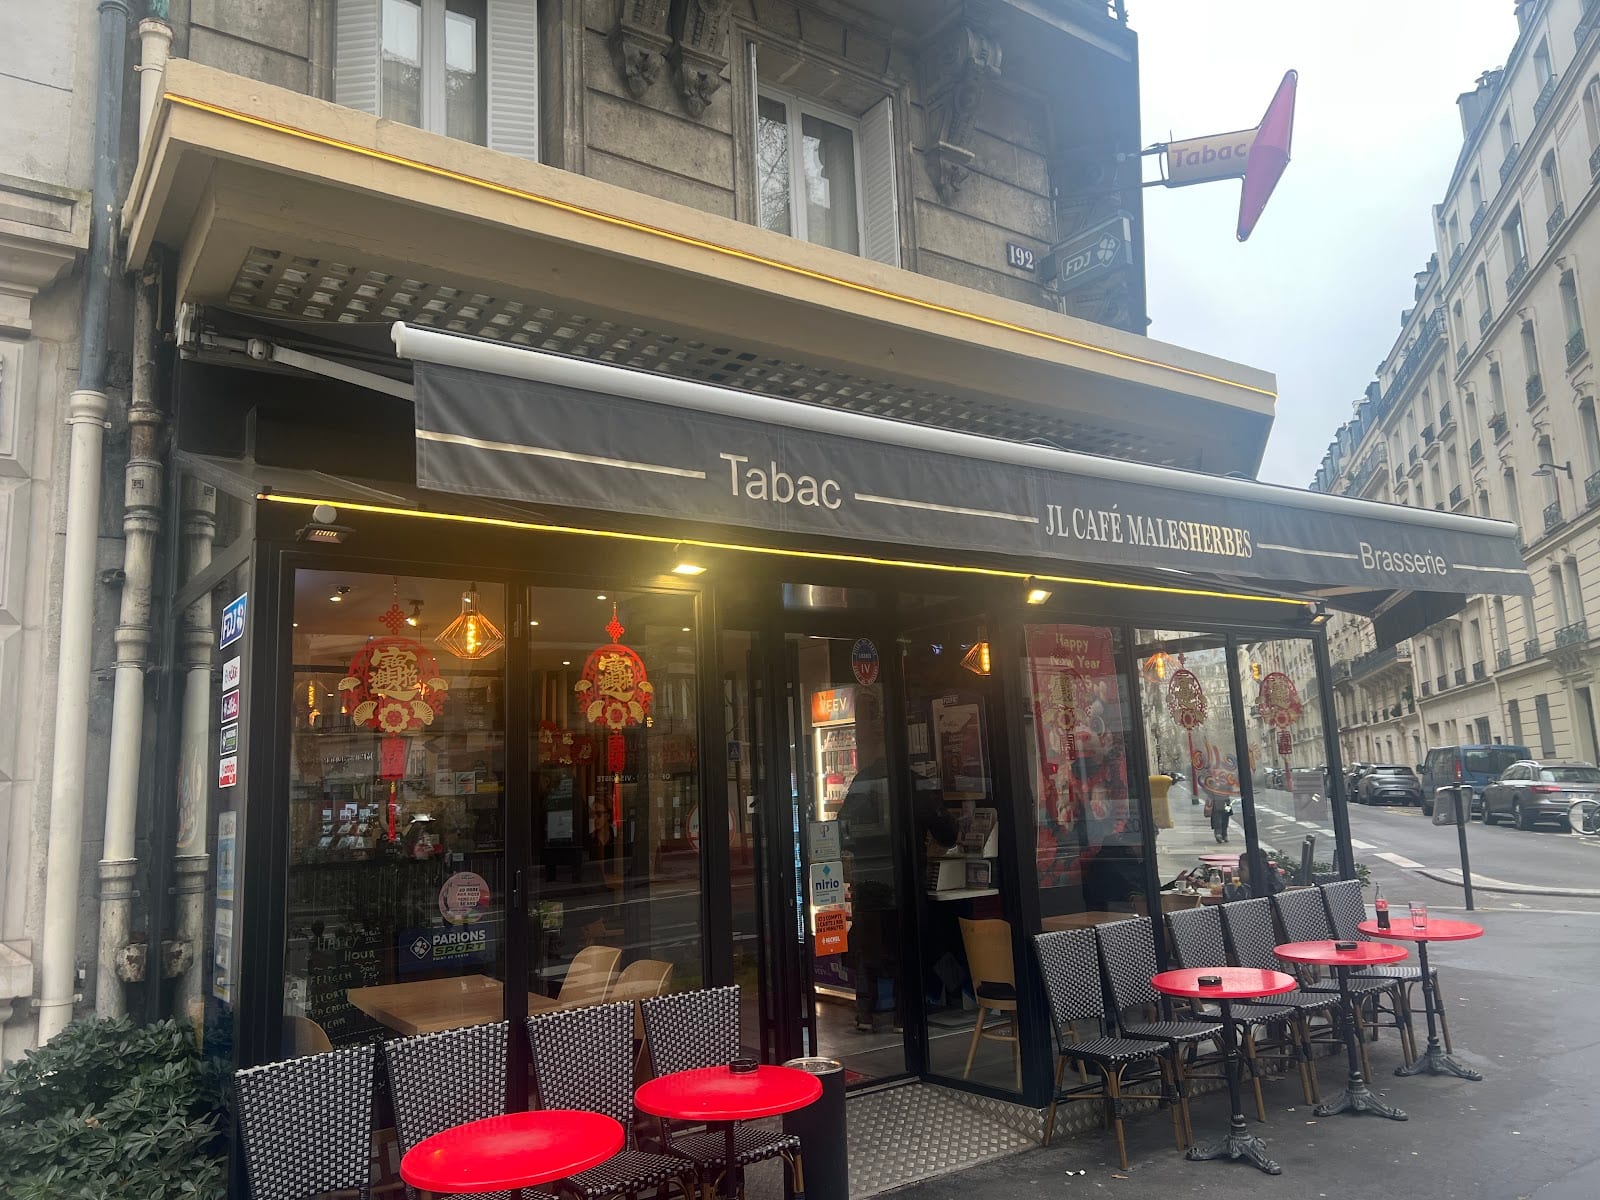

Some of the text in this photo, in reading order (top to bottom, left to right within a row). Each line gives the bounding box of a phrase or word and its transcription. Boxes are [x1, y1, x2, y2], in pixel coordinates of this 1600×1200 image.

[1173, 143, 1247, 167] Tabac
[1009, 245, 1034, 270] 192
[1066, 251, 1091, 276] FDJ
[719, 452, 842, 510] Tabac
[1045, 504, 1253, 559] JL CAFÉ MALESHERBES
[1359, 542, 1448, 575] Brasserie
[222, 608, 237, 641] FDJ
[1055, 633, 1088, 653] Happy
[861, 663, 871, 674] IV
[1076, 655, 1101, 669] Year
[819, 696, 847, 713] VEEV
[815, 879, 839, 890] nirio
[317, 936, 360, 951] HAPPY
[433, 930, 486, 945] PARIONS
[344, 949, 376, 962] HOUR
[434, 942, 485, 956] SPORT
